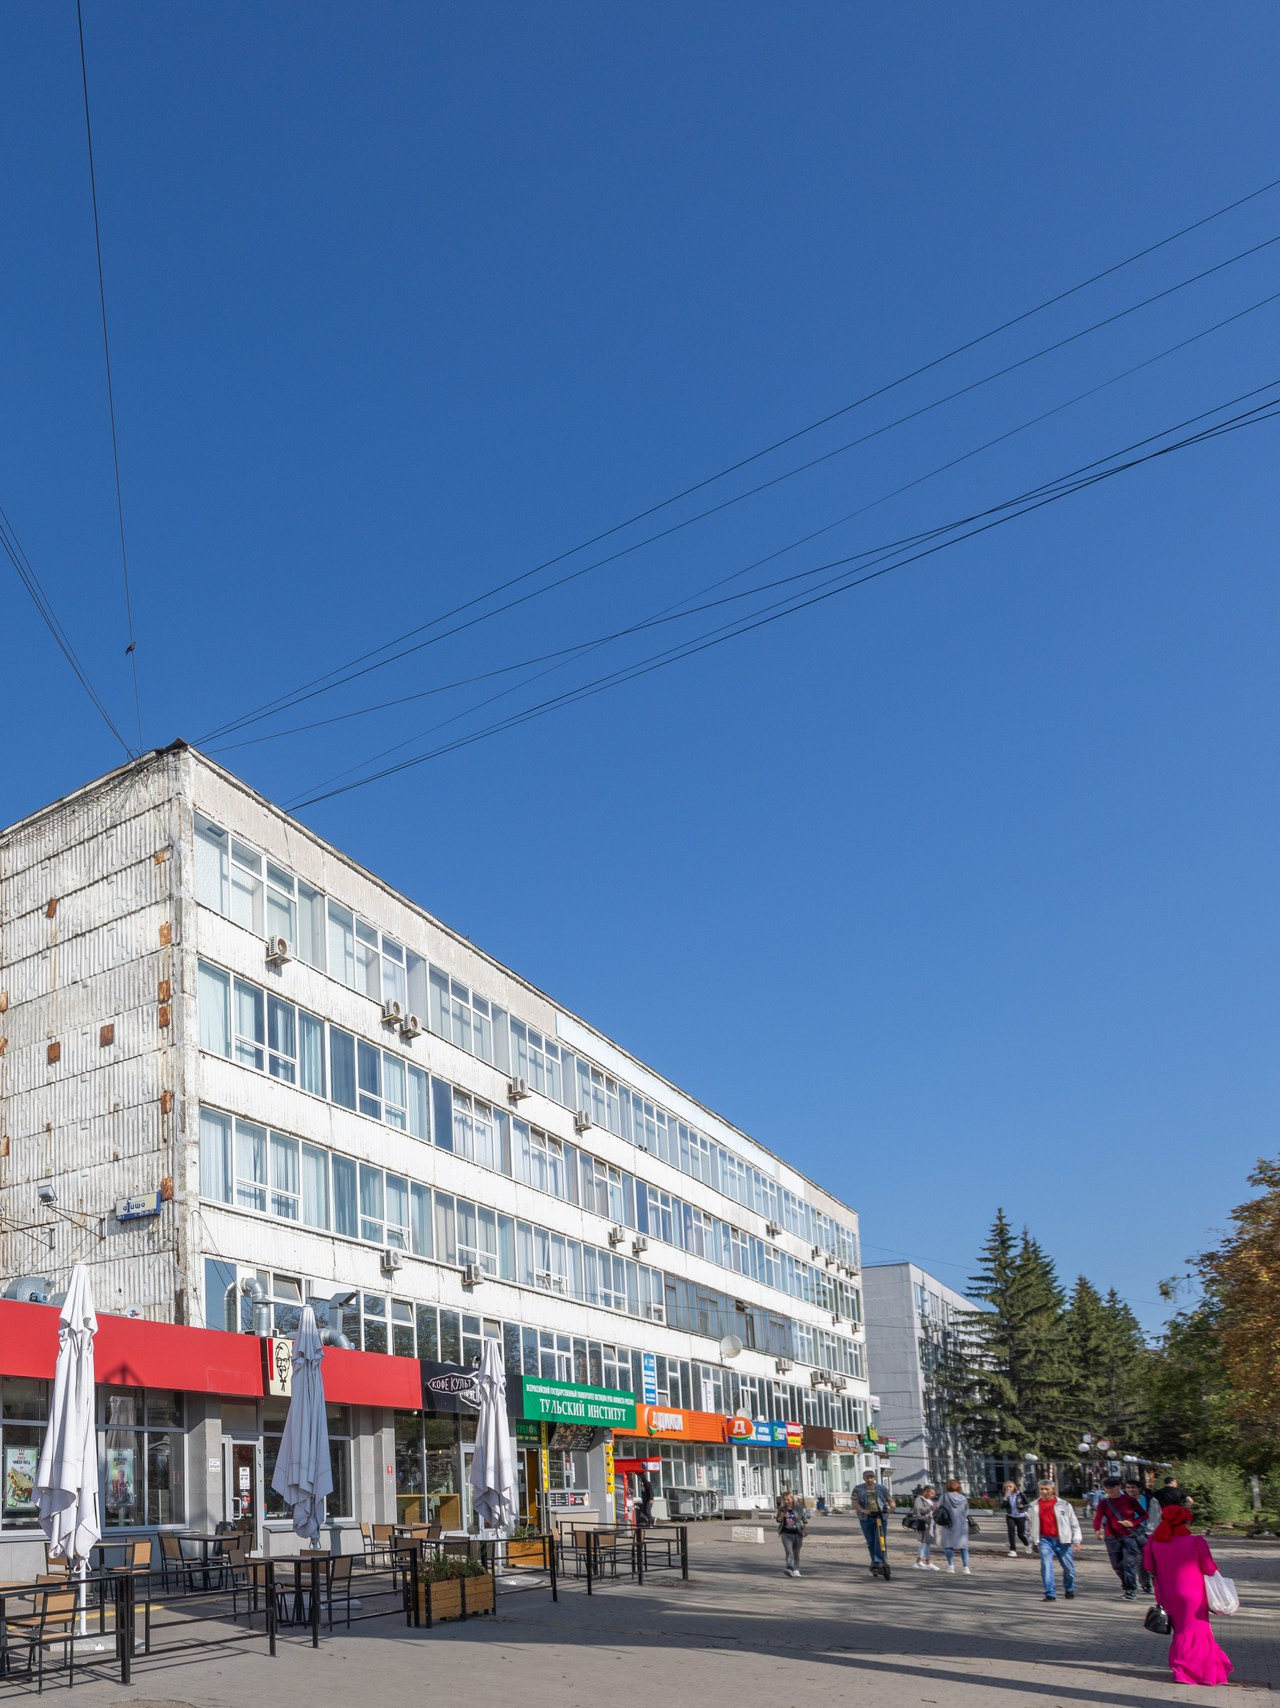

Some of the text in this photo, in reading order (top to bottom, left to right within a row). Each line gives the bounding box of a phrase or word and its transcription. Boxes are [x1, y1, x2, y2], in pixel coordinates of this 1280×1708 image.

[432, 1377, 472, 1391] КОФЕ КУЛЬТ
[539, 1398, 626, 1421] ТУЛЬСКИЙ ИНСТИТУТ
[733, 1420, 746, 1434] Д
